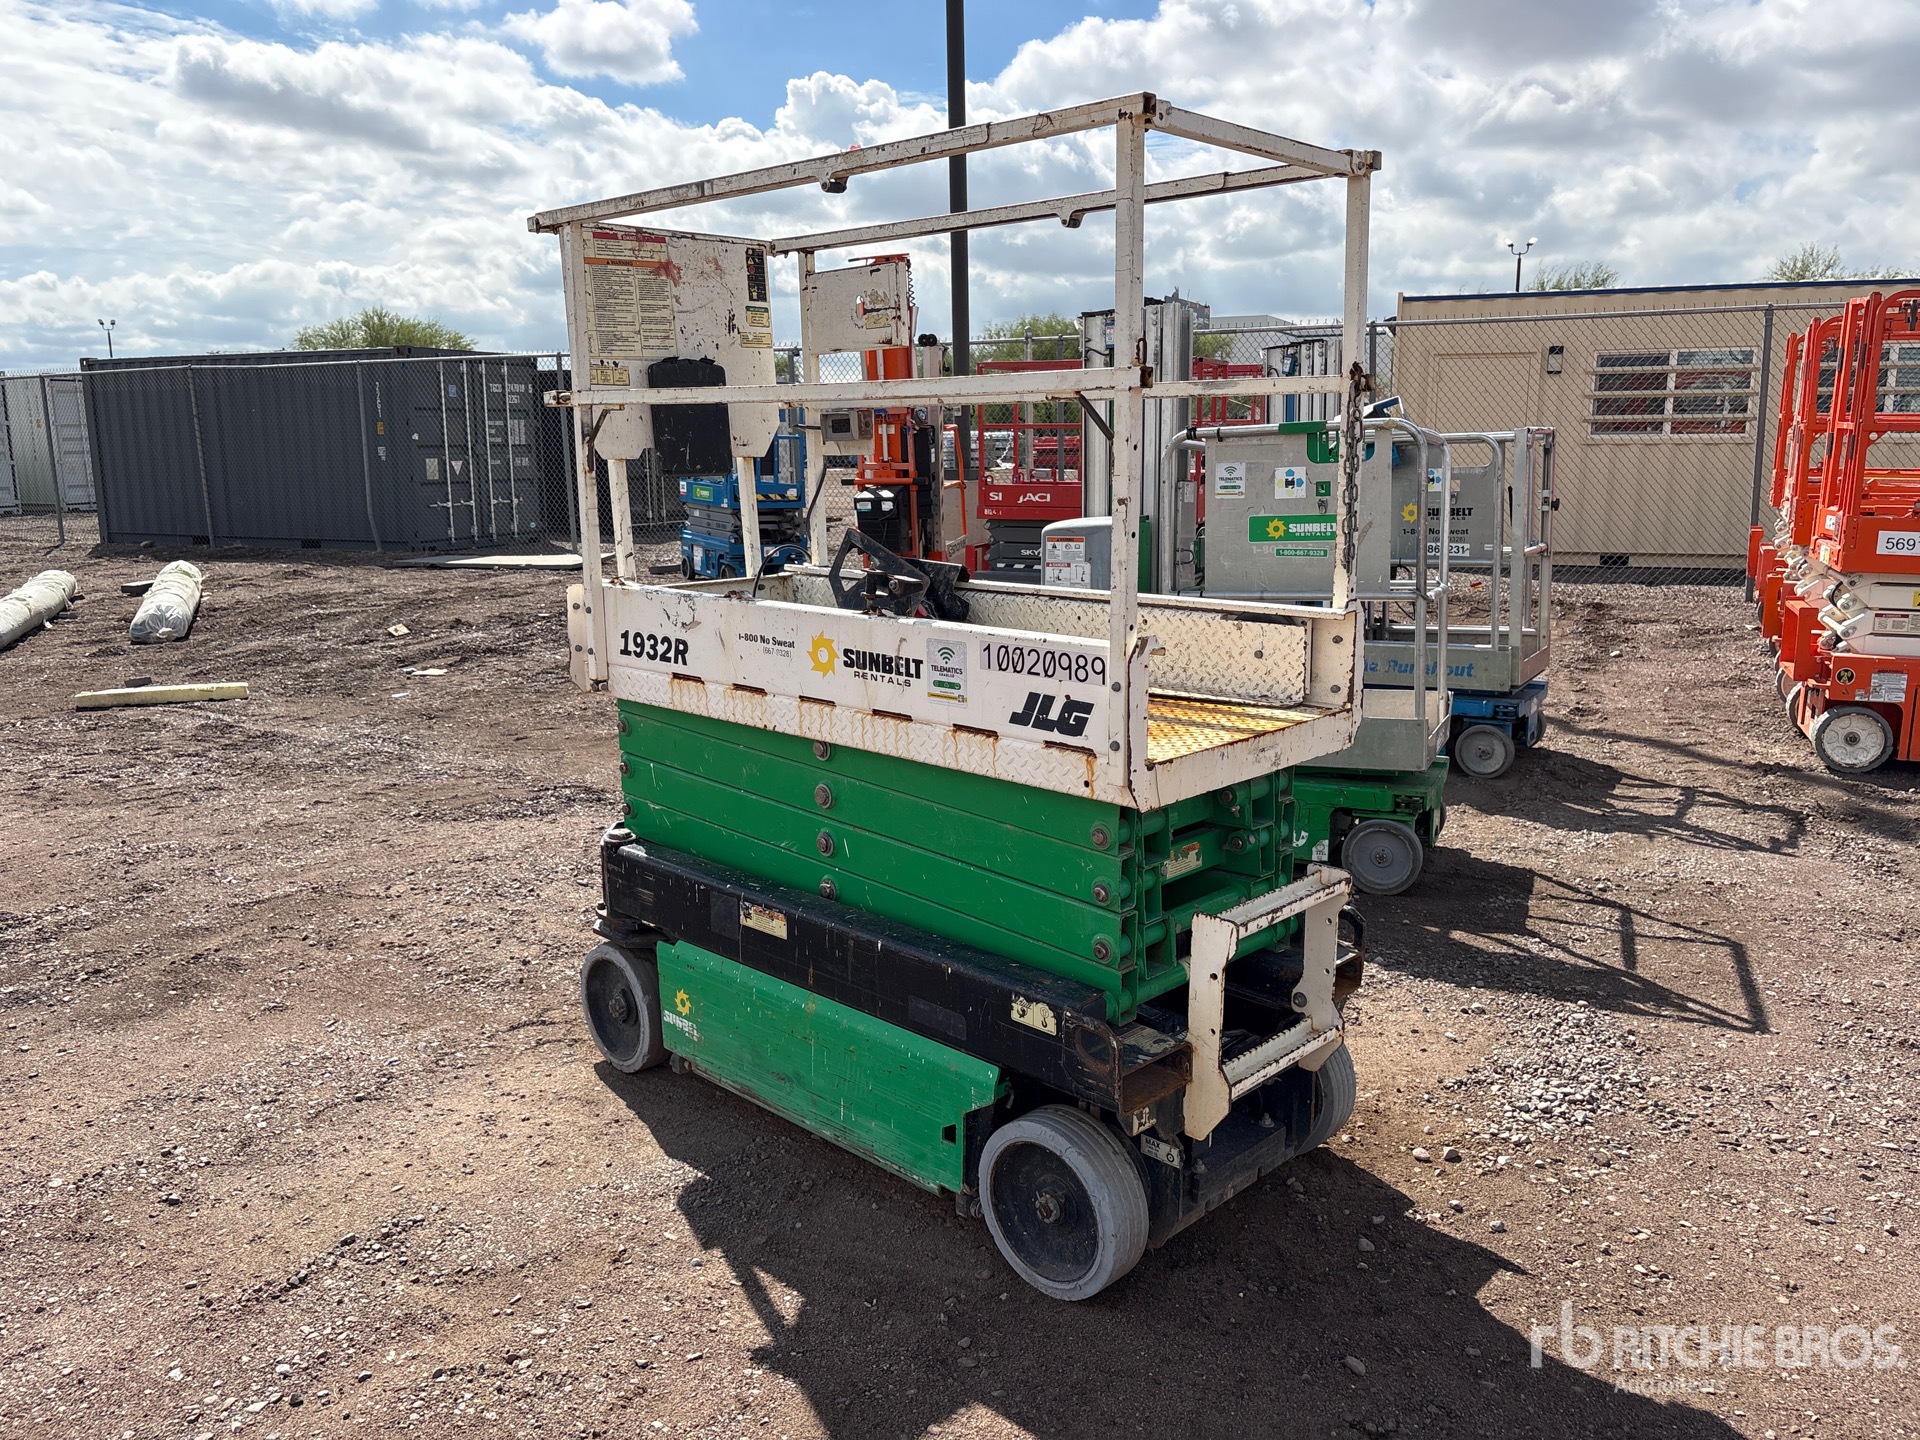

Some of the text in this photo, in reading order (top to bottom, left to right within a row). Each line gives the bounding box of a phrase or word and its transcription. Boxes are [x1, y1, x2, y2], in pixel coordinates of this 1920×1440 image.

[1885, 537, 1920, 551] 569
[619, 629, 689, 666] 1932R
[759, 634, 771, 645] No
[771, 636, 796, 649] Sweat
[843, 647, 924, 680] SUNBELT
[930, 664, 963, 675] TELEMATICS
[982, 642, 1107, 686] 10020989
[853, 671, 912, 688] RENTALS
[1008, 691, 1095, 738] JLG
[1145, 1137, 1160, 1149] MAX
